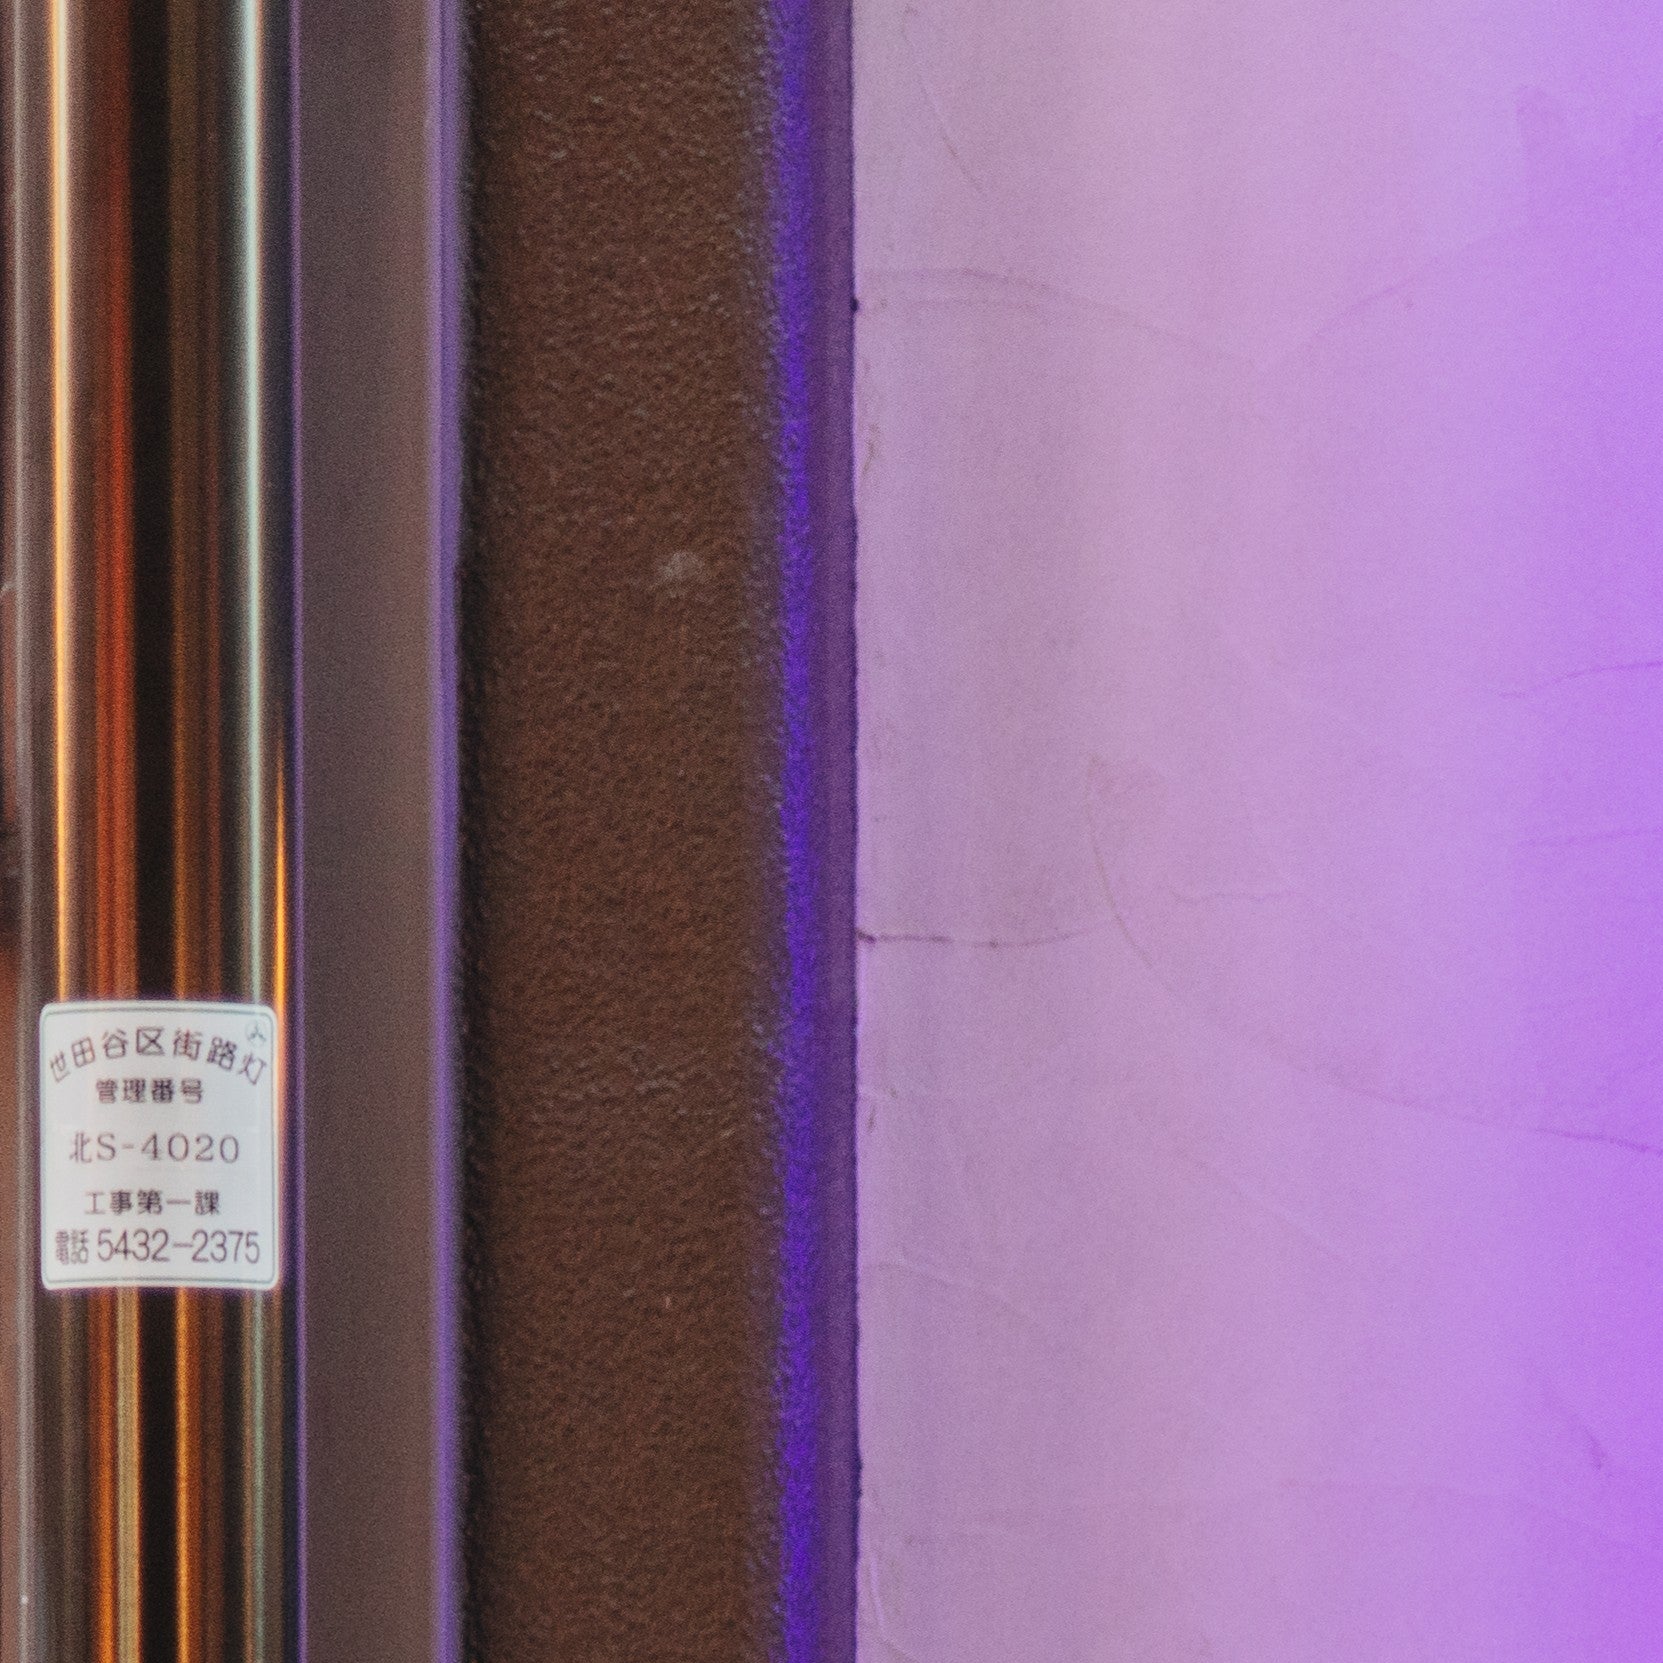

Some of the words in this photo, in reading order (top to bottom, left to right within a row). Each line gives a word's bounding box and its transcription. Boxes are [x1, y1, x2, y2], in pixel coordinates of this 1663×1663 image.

[50, 1026, 268, 1084] 世田谷区街路灯
[96, 1078, 204, 1103] 管理番号
[69, 1132, 240, 1164] 北S-4020
[85, 1190, 220, 1216] 工事第一課
[98, 1229, 260, 1263] 5432-2375
